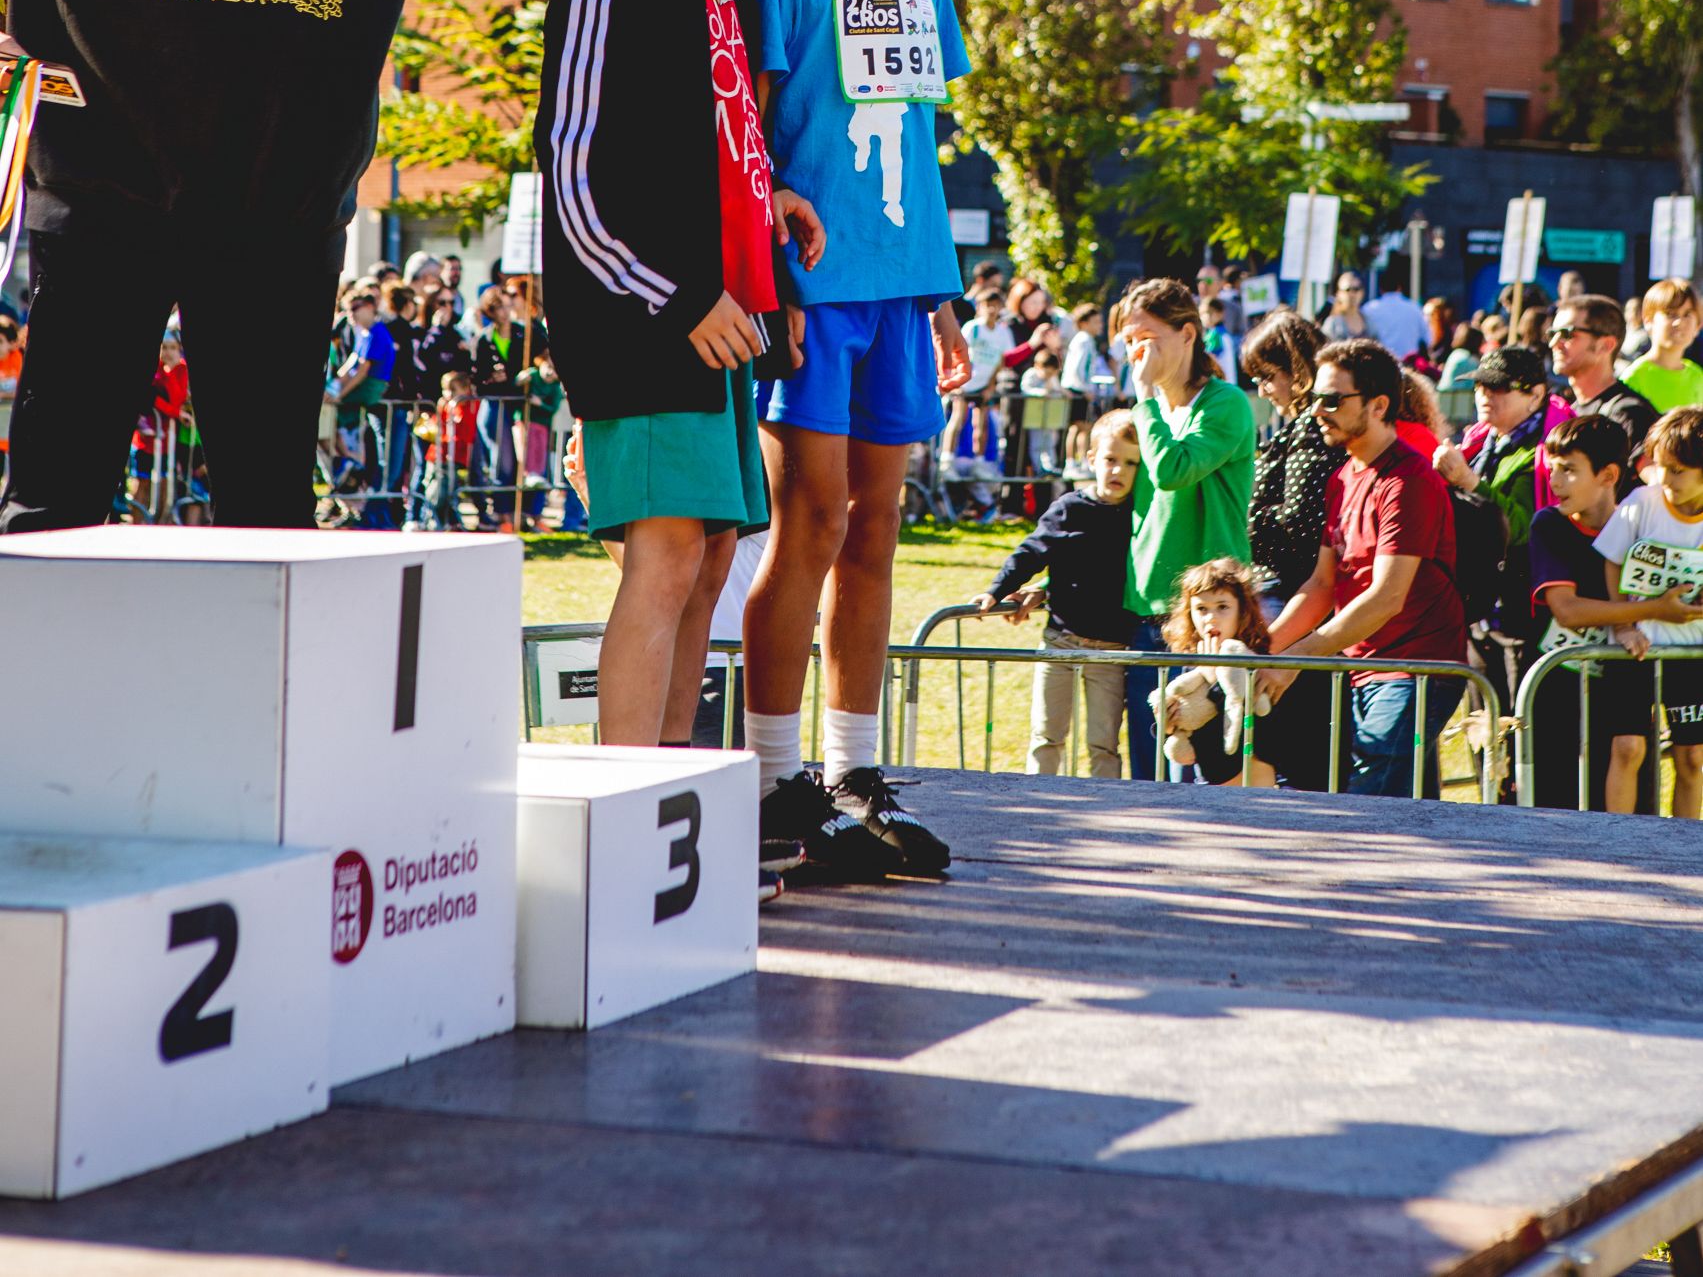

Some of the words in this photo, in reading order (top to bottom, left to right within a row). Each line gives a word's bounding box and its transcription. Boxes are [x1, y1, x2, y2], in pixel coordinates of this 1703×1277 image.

[846, 8, 900, 28] CROS
[862, 46, 936, 75] 1592
[393, 563, 424, 733] 1
[384, 838, 478, 894] Diputació
[653, 789, 702, 925] 3
[383, 892, 477, 939] Barcelona
[157, 902, 239, 1064] 2
